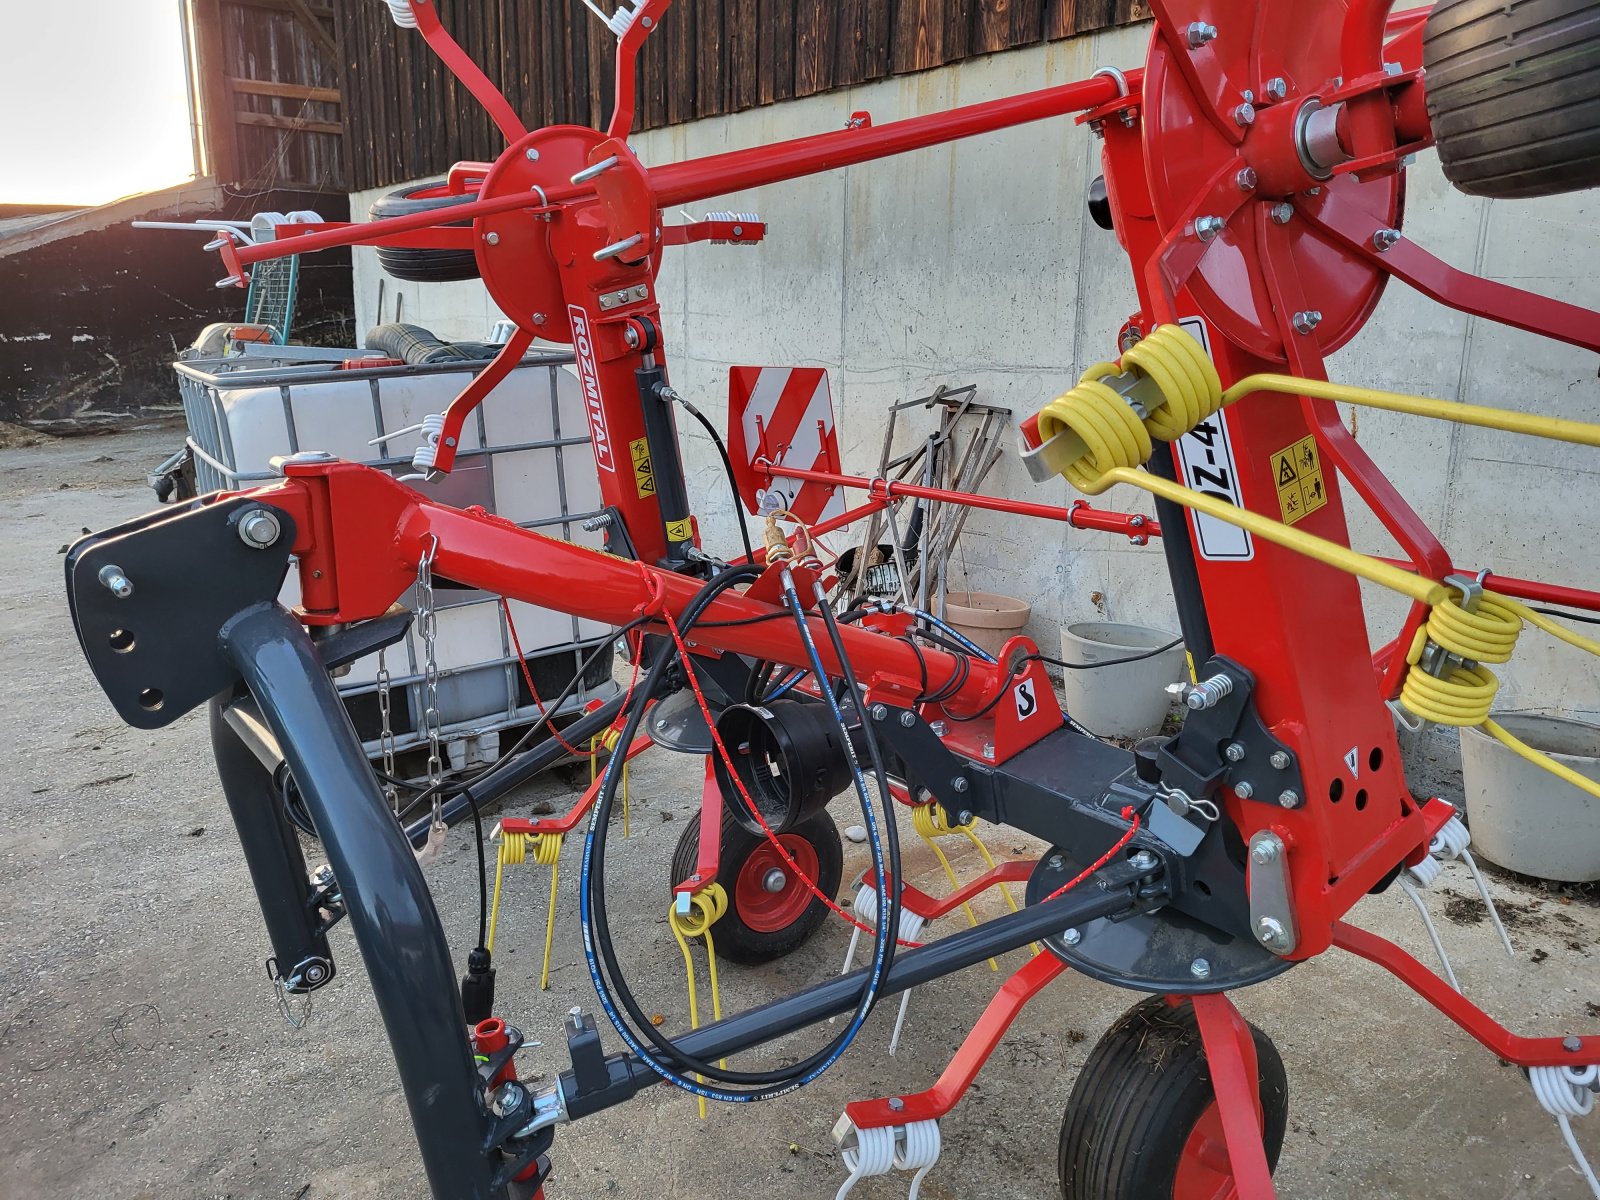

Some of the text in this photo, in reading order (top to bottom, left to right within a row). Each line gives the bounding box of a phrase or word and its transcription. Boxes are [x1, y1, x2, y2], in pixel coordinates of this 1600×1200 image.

[572, 316, 611, 459] ROZMITAL
[1067, 719, 1096, 740] SEMPERIT
[839, 721, 857, 759] SEMPERIT
[589, 790, 605, 831] SEMPERIT
[592, 977, 602, 990] PSI
[640, 1053, 655, 1067] BAR
[652, 1063, 664, 1075] 225
[662, 1071, 673, 1081] WP
[759, 1082, 800, 1100] SEMPERIT
